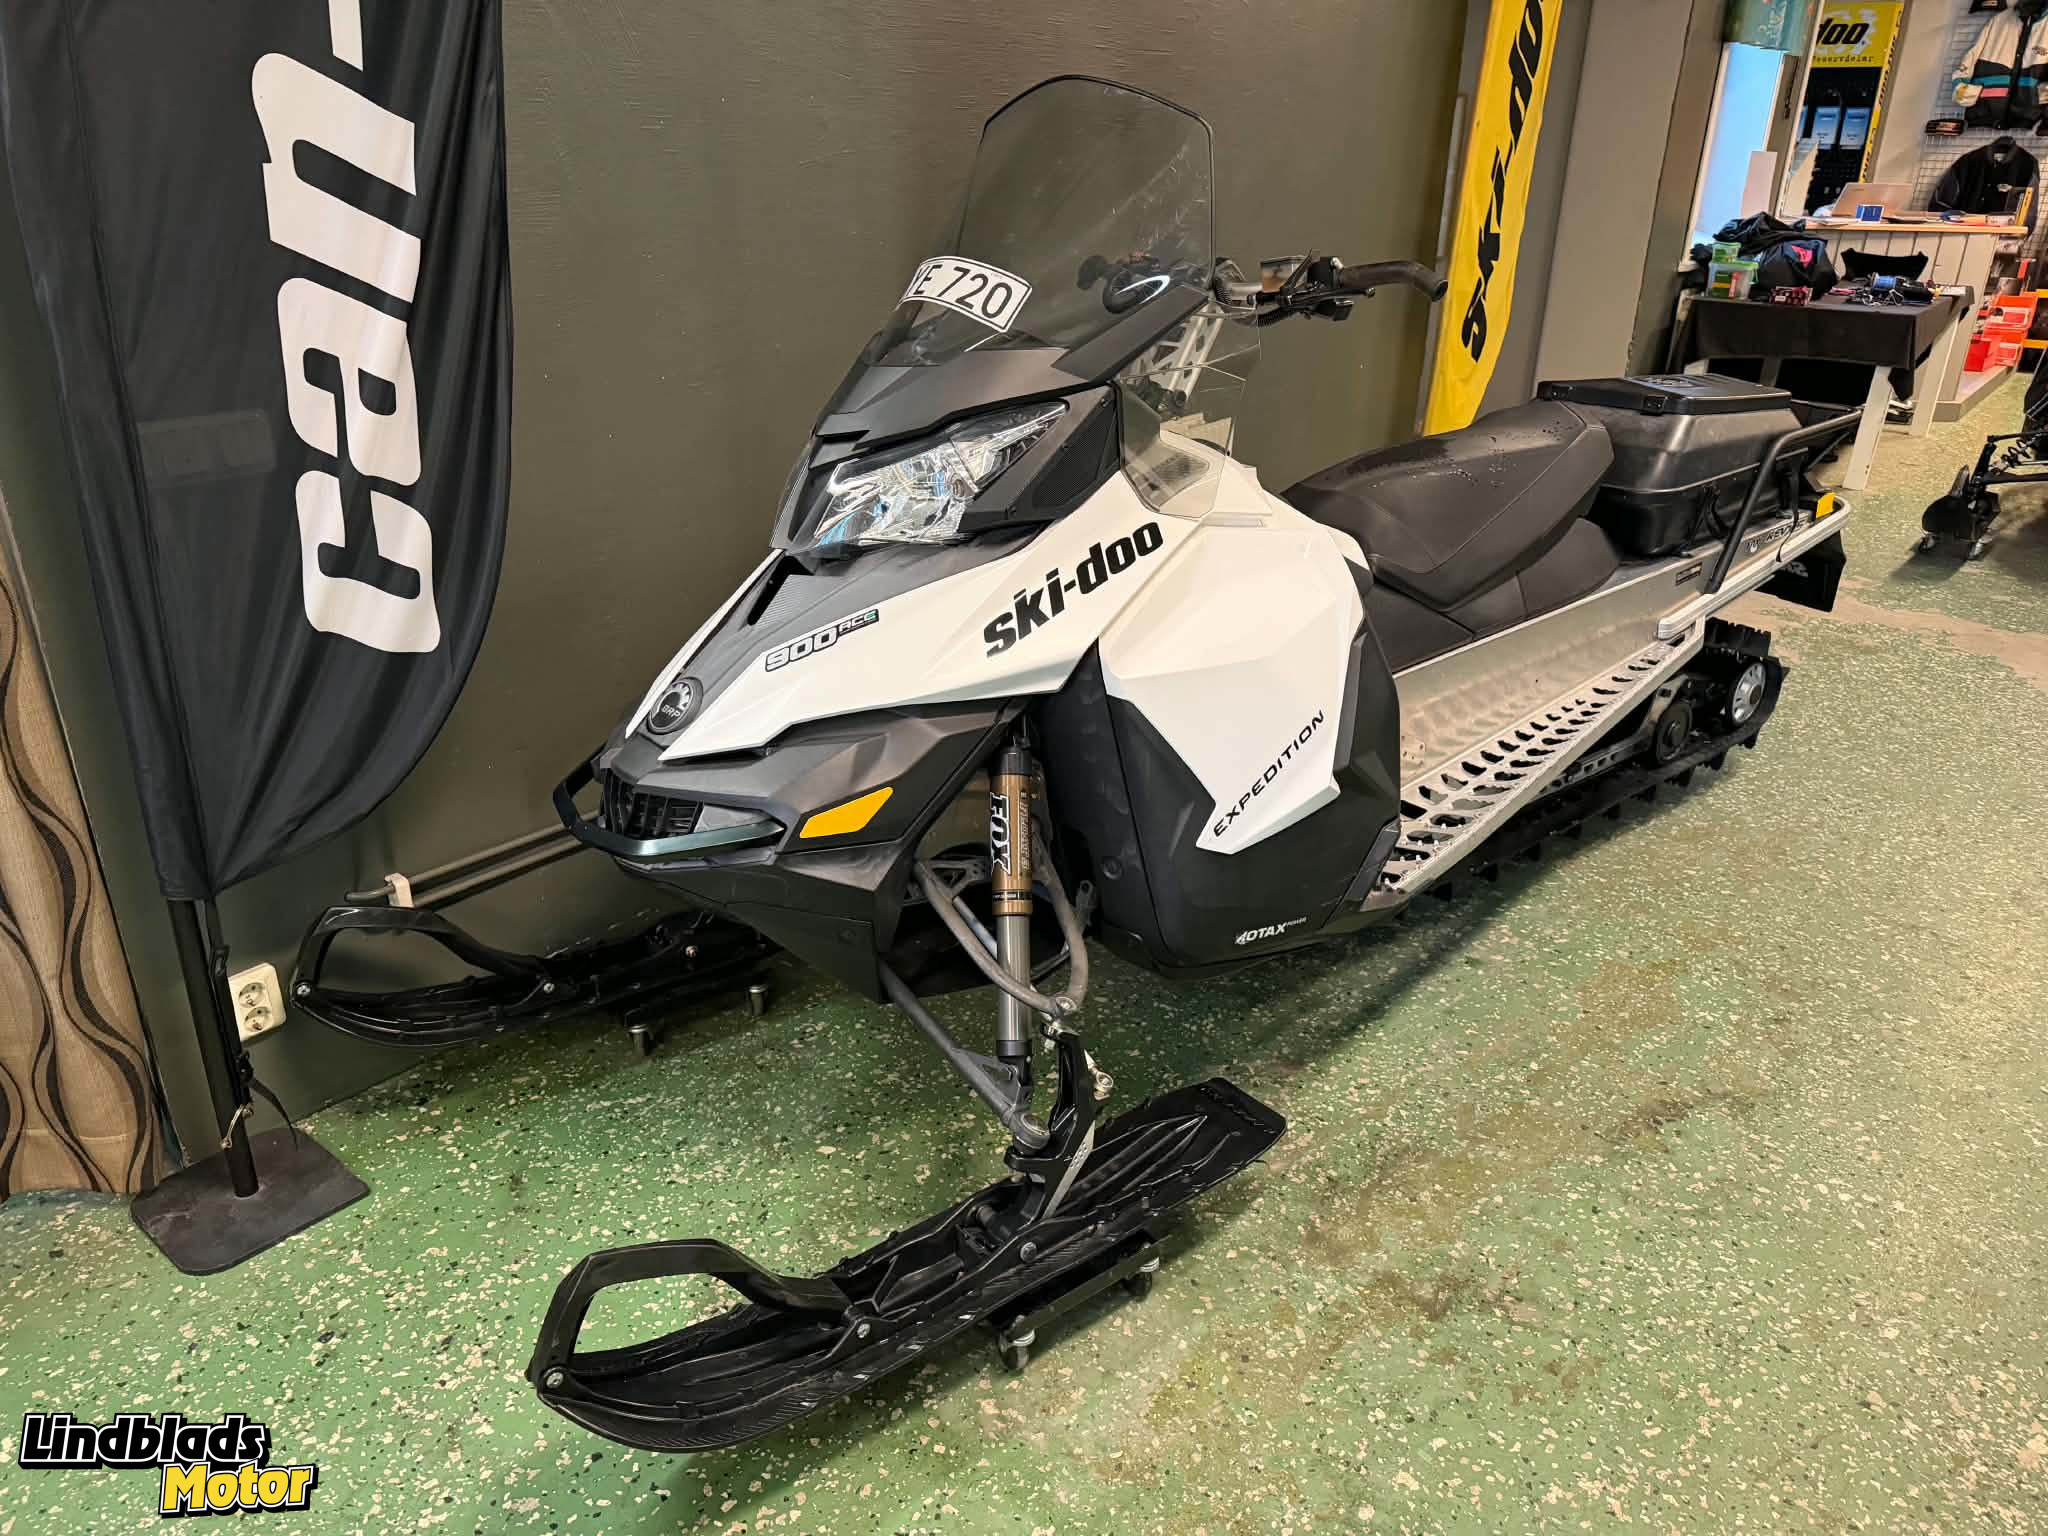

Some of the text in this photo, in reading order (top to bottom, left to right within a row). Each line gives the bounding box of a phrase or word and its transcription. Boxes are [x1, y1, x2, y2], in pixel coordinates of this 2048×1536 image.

[936, 265, 1013, 319] 720
[983, 521, 1164, 658] ski-doo
[765, 609, 879, 672] 900 ACE
[661, 703, 681, 718] BRP
[1213, 710, 1325, 837] EXPEDITION
[990, 791, 1011, 876] FOX
